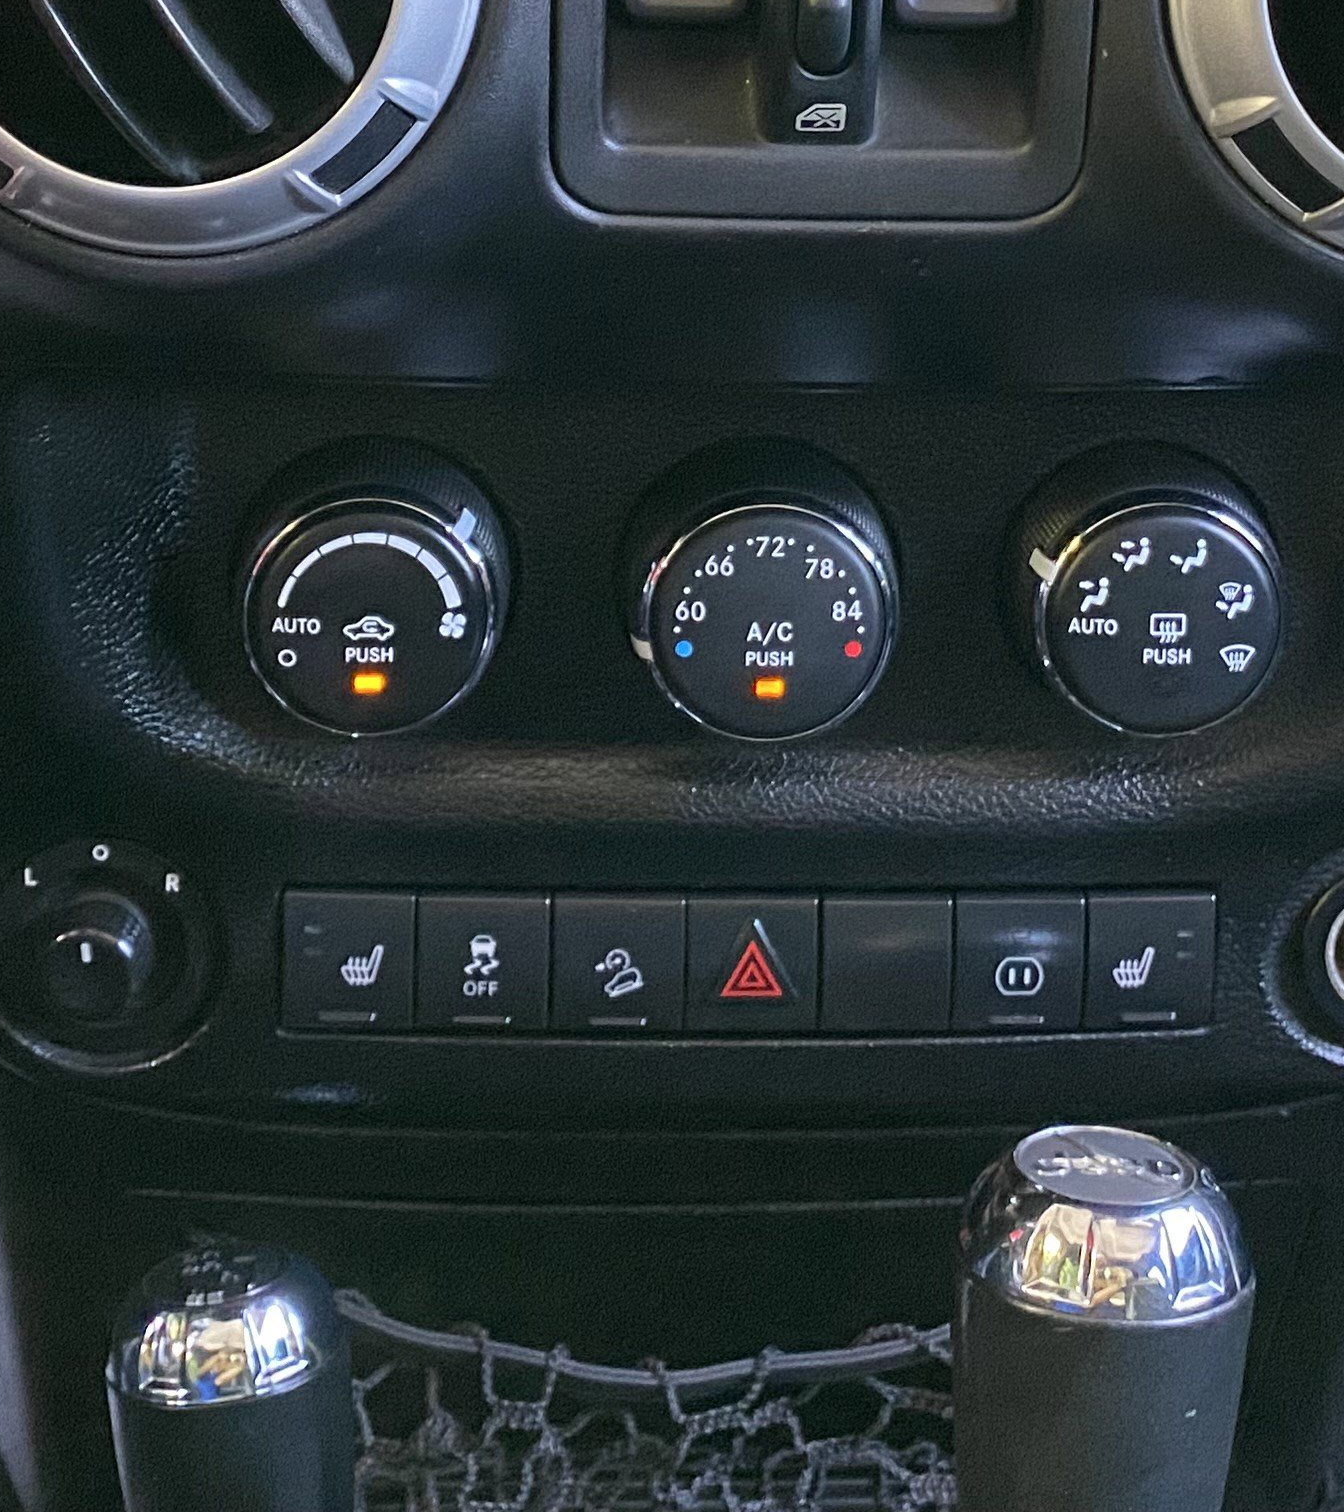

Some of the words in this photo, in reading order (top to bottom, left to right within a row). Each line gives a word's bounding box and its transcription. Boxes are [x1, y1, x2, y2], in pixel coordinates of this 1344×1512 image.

[755, 535, 786, 558] 72
[704, 554, 735, 577] 66
[805, 557, 835, 580] 78
[675, 600, 707, 622] 60
[832, 599, 863, 622] 84
[271, 616, 321, 635] AUTO
[746, 621, 794, 645] A/C
[1067, 616, 1119, 636] AUTO
[344, 646, 394, 664] PUSH
[745, 650, 794, 667] PUSH
[1142, 647, 1192, 665] PUSH
[24, 867, 38, 887] L
[165, 873, 180, 893] R
[462, 980, 499, 997] OFF
